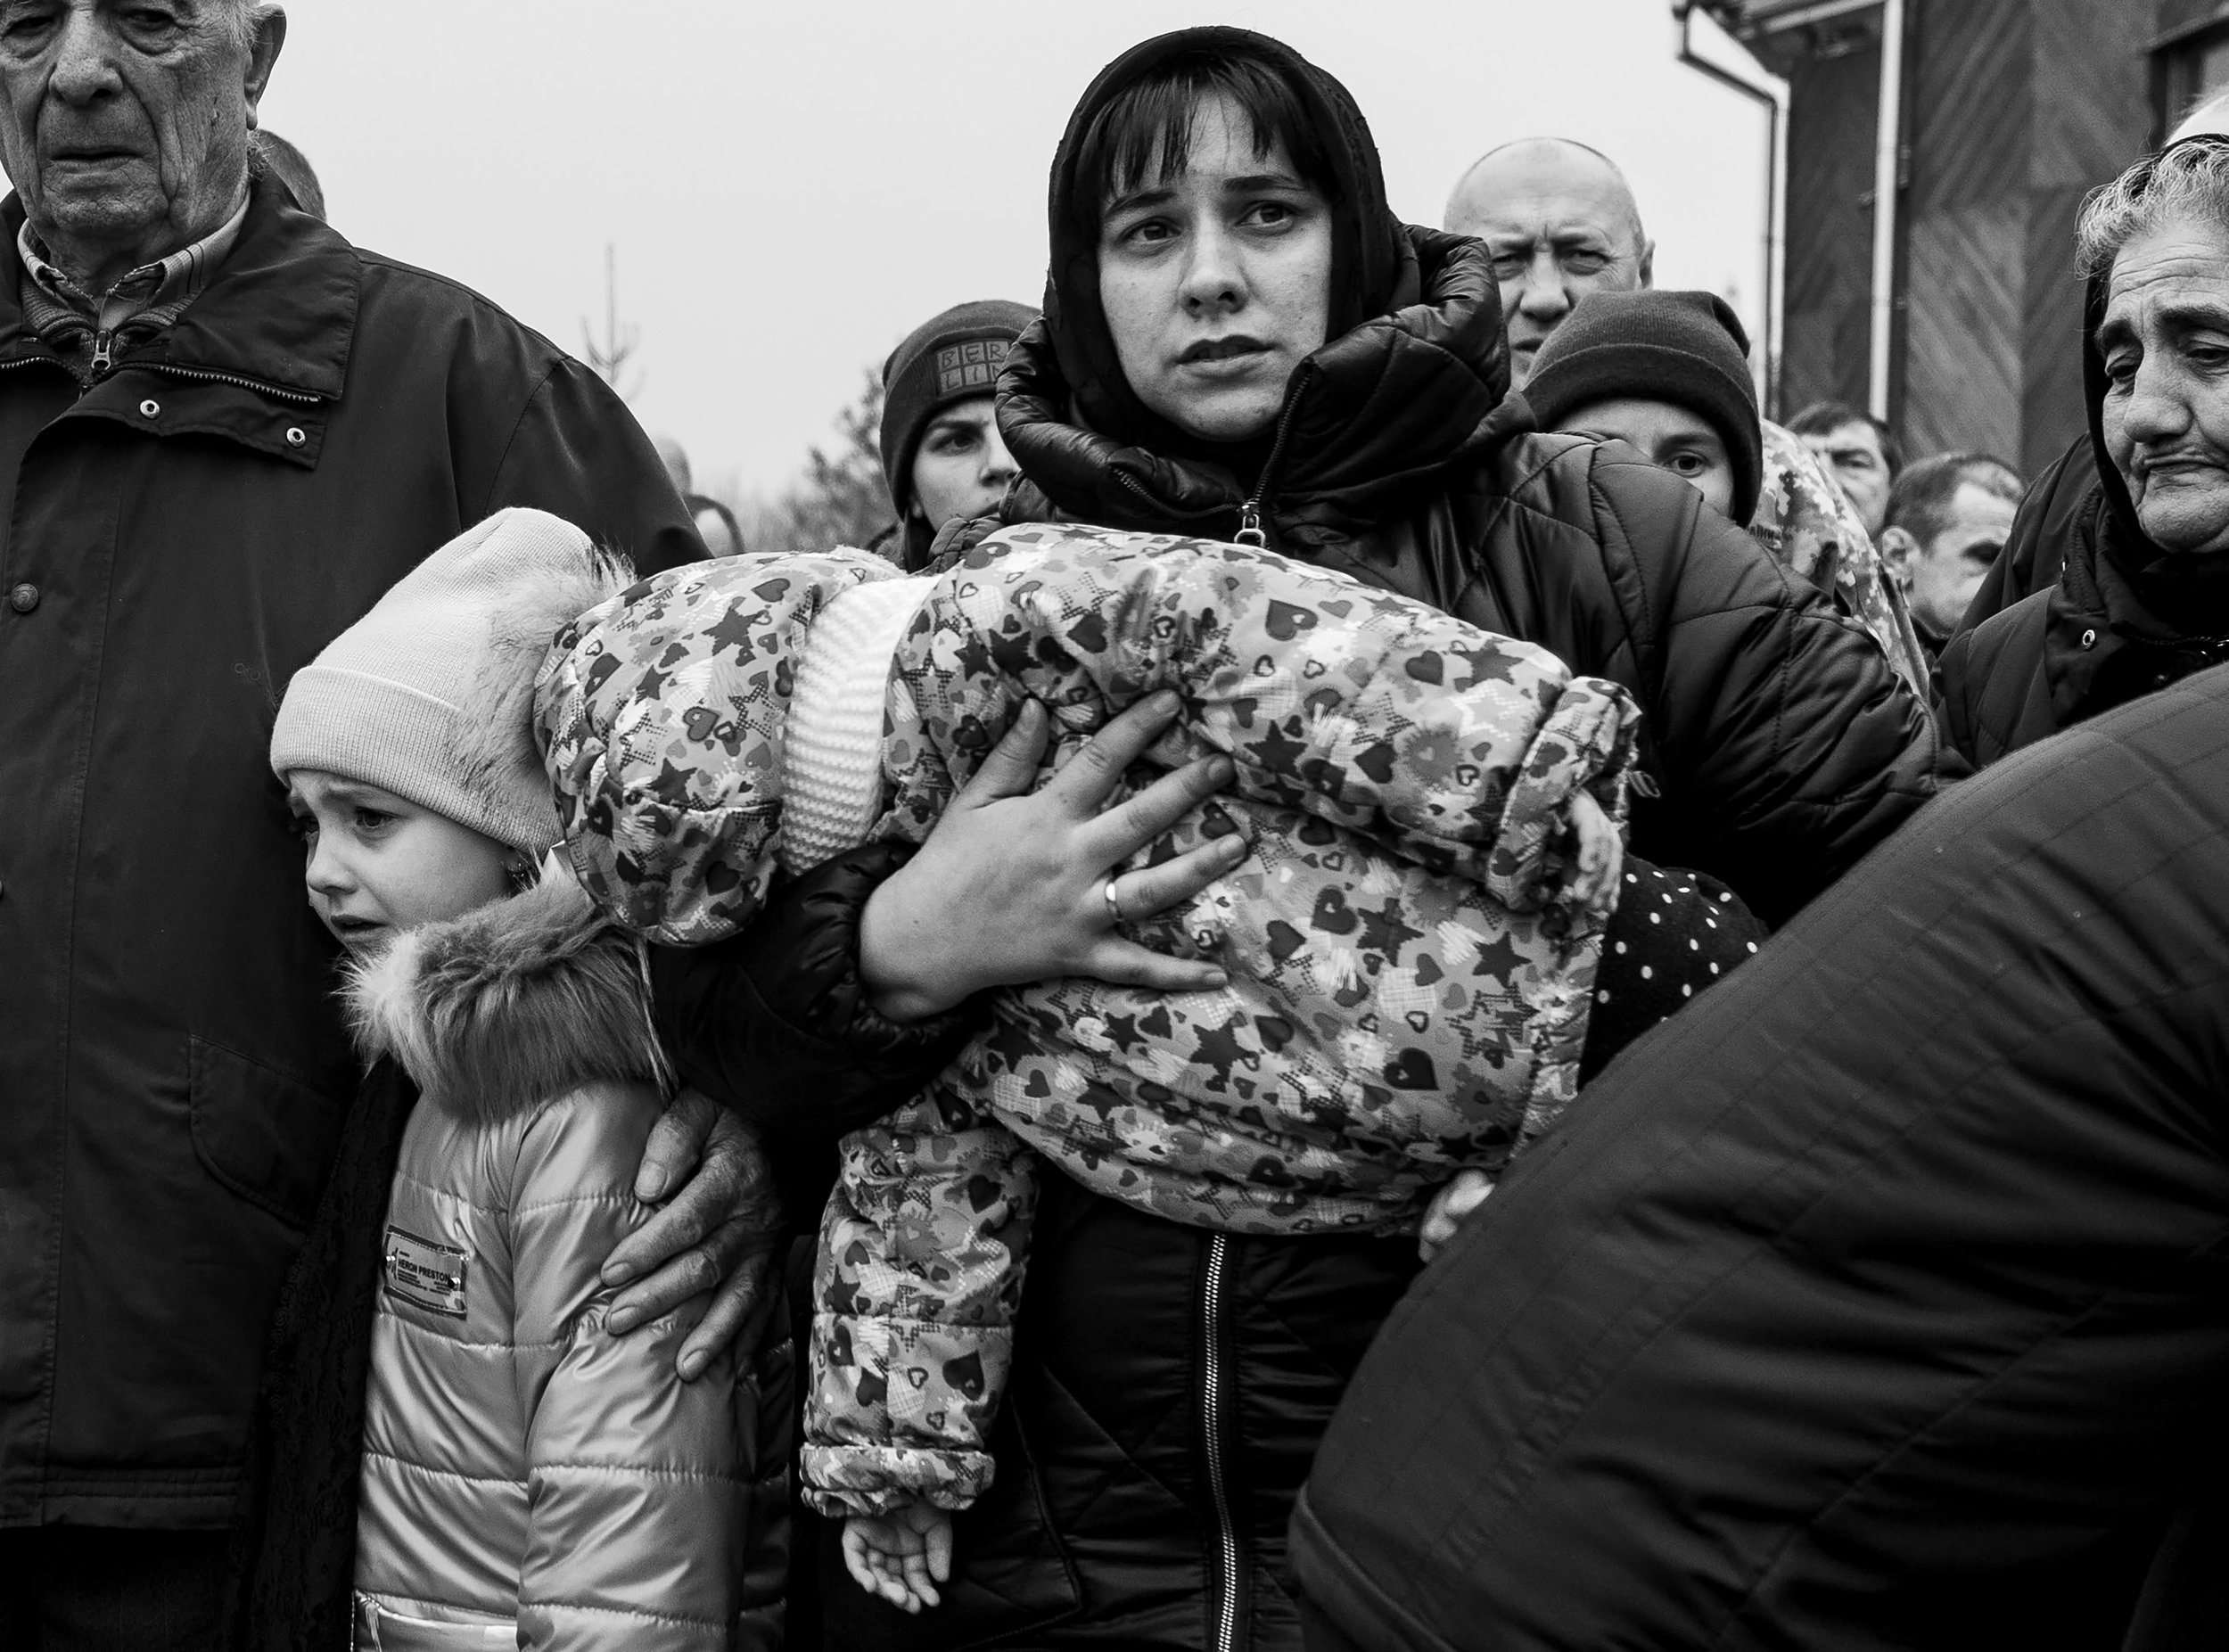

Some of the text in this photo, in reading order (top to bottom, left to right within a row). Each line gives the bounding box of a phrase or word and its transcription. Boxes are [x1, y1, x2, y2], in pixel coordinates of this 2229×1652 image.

[942, 345, 1005, 367] BER
[398, 1259, 450, 1282] HERON PRESTON
